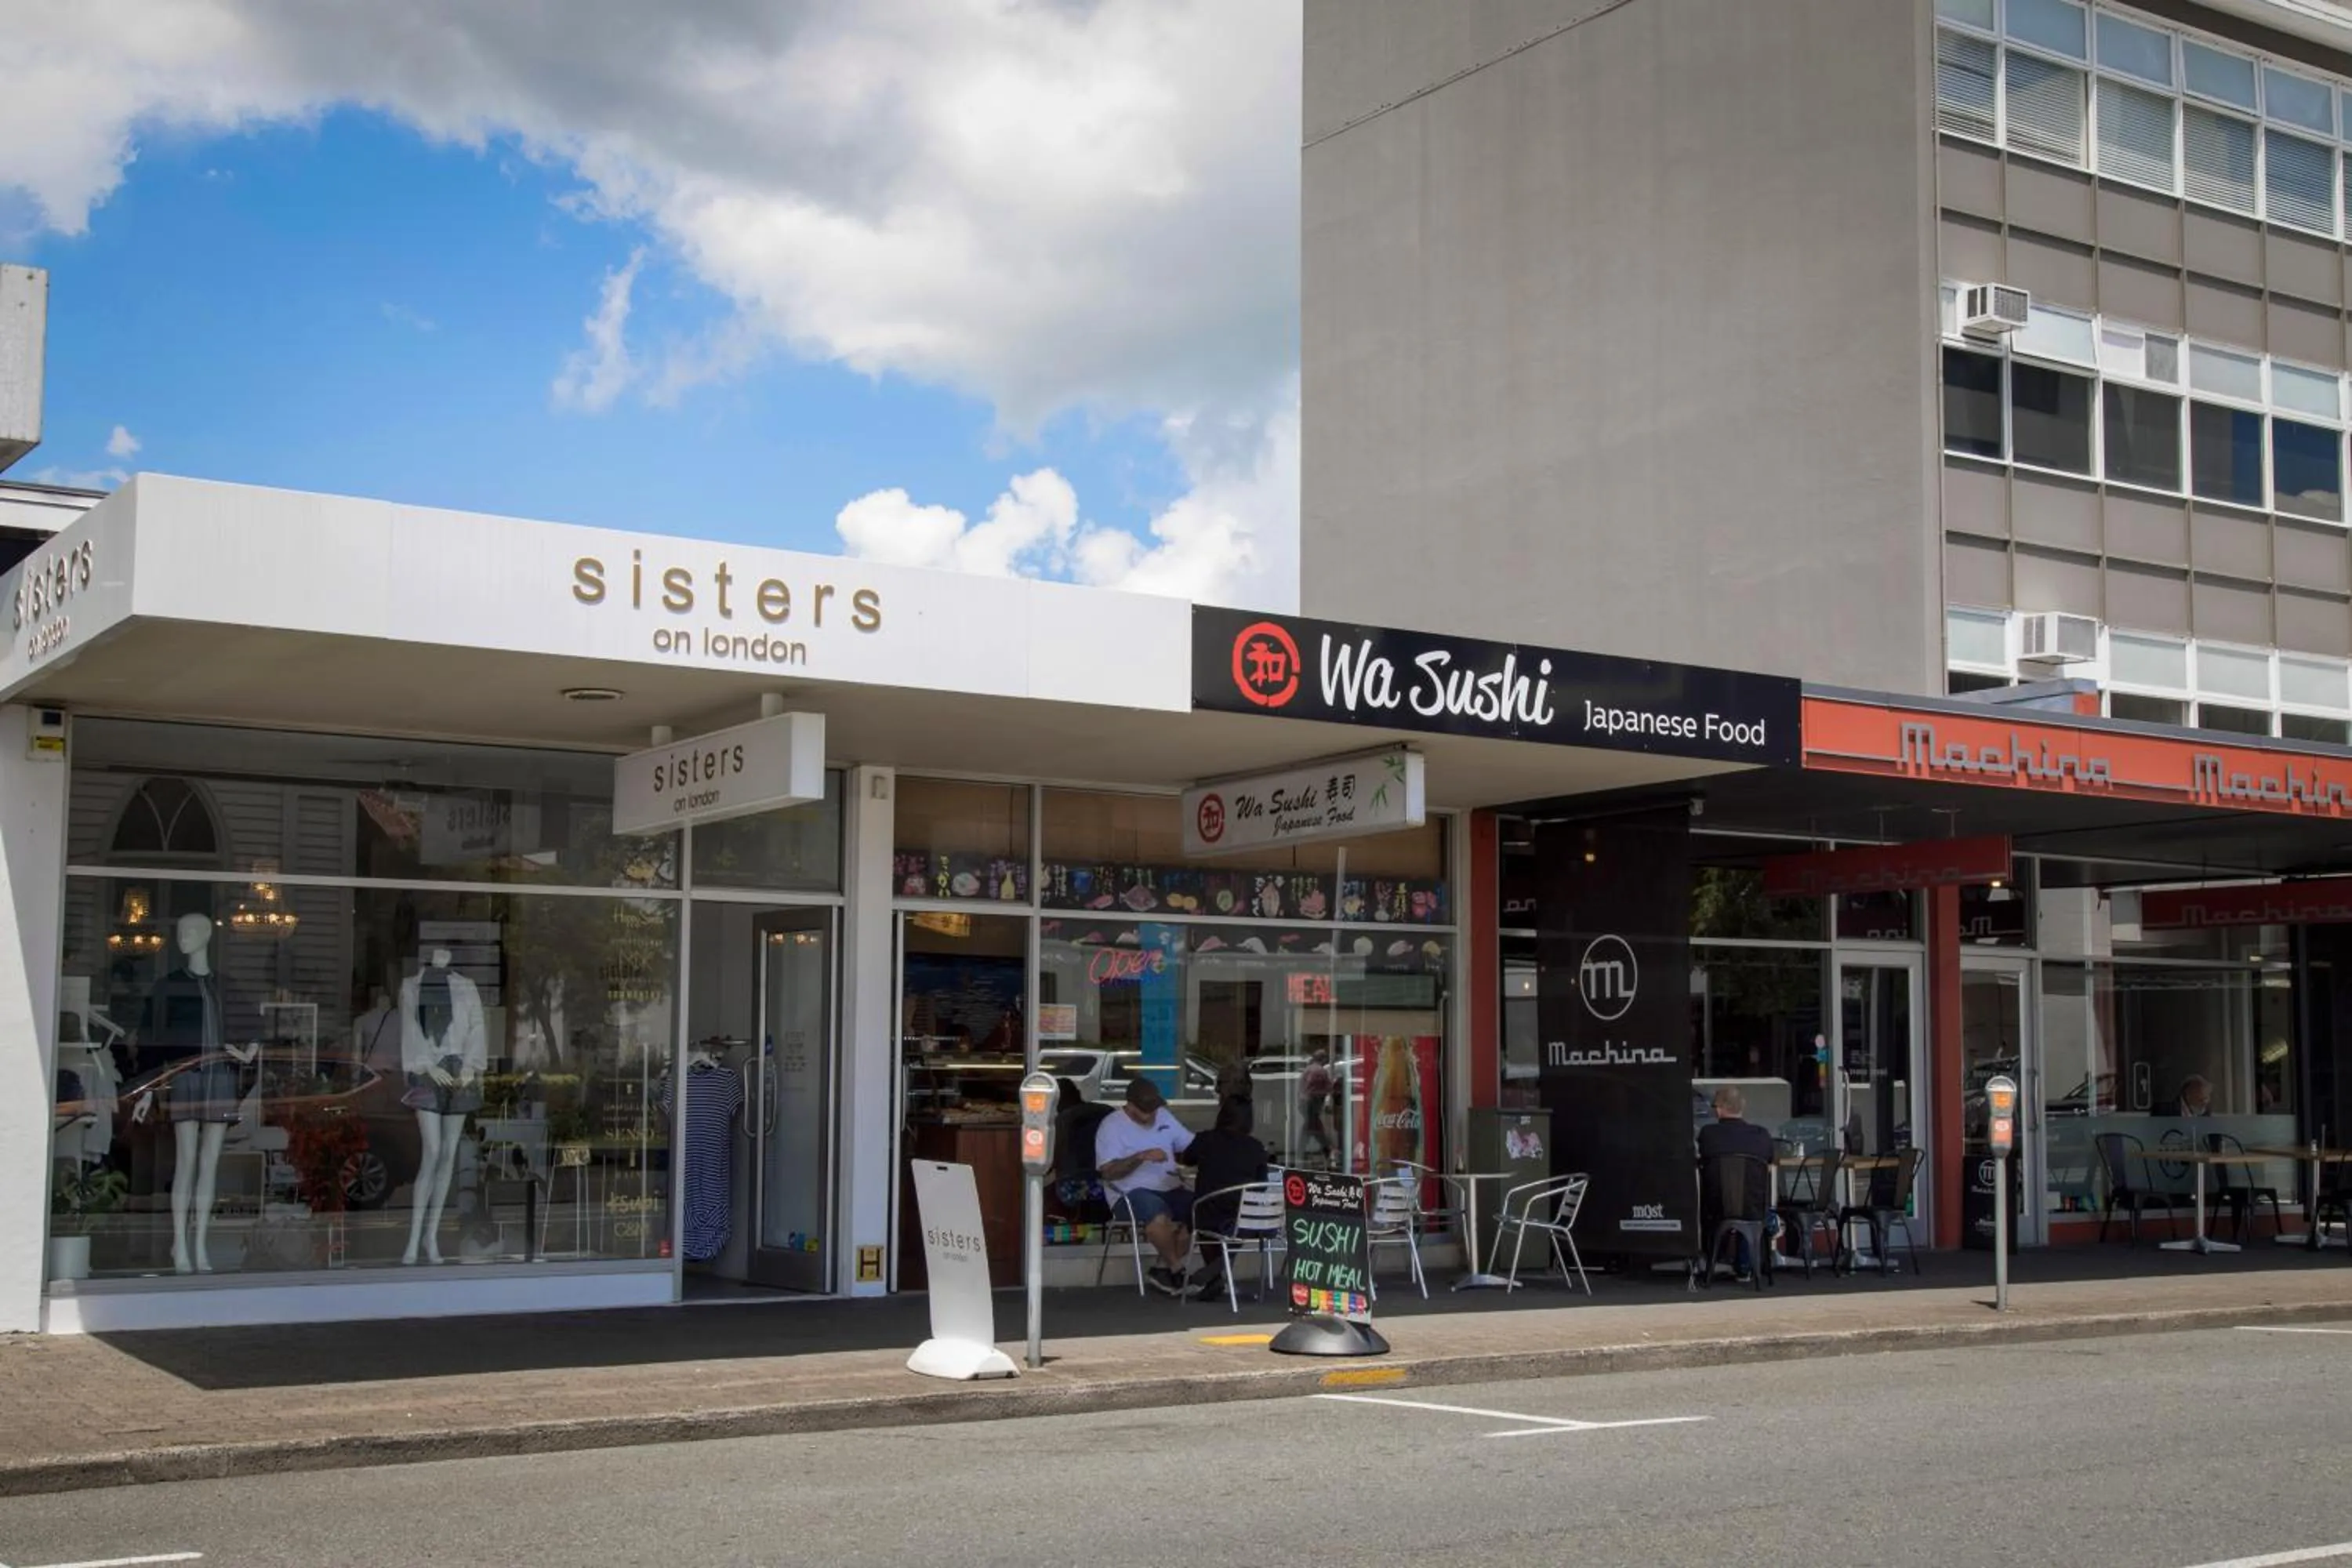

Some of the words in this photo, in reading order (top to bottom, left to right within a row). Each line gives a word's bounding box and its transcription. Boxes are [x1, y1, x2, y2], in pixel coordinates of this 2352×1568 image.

[13, 539, 93, 631] sisters
[572, 549, 881, 633] sisters
[652, 627, 691, 654] on
[704, 626, 807, 665] london
[1319, 633, 1401, 711] Wa
[1411, 650, 1554, 725] Sushi
[1584, 699, 1697, 739] Japanese
[1705, 713, 1765, 746] Food
[654, 744, 744, 793] sisters
[1900, 720, 2111, 782] Machina
[2193, 752, 2352, 807] Machin
[674, 797, 686, 812] on
[688, 789, 720, 811] london
[1235, 793, 1263, 820] Wa
[1269, 786, 1318, 815] Sushi
[1273, 815, 1323, 837] Japanese
[1327, 806, 1356, 826] Food
[1548, 1040, 1678, 1067] Machina
[927, 1225, 981, 1253] sisters
[1293, 1218, 1360, 1254] SUSHI
[860, 1247, 880, 1278] H
[1294, 1258, 1323, 1281] HOT
[1327, 1264, 1366, 1291] MEAL
